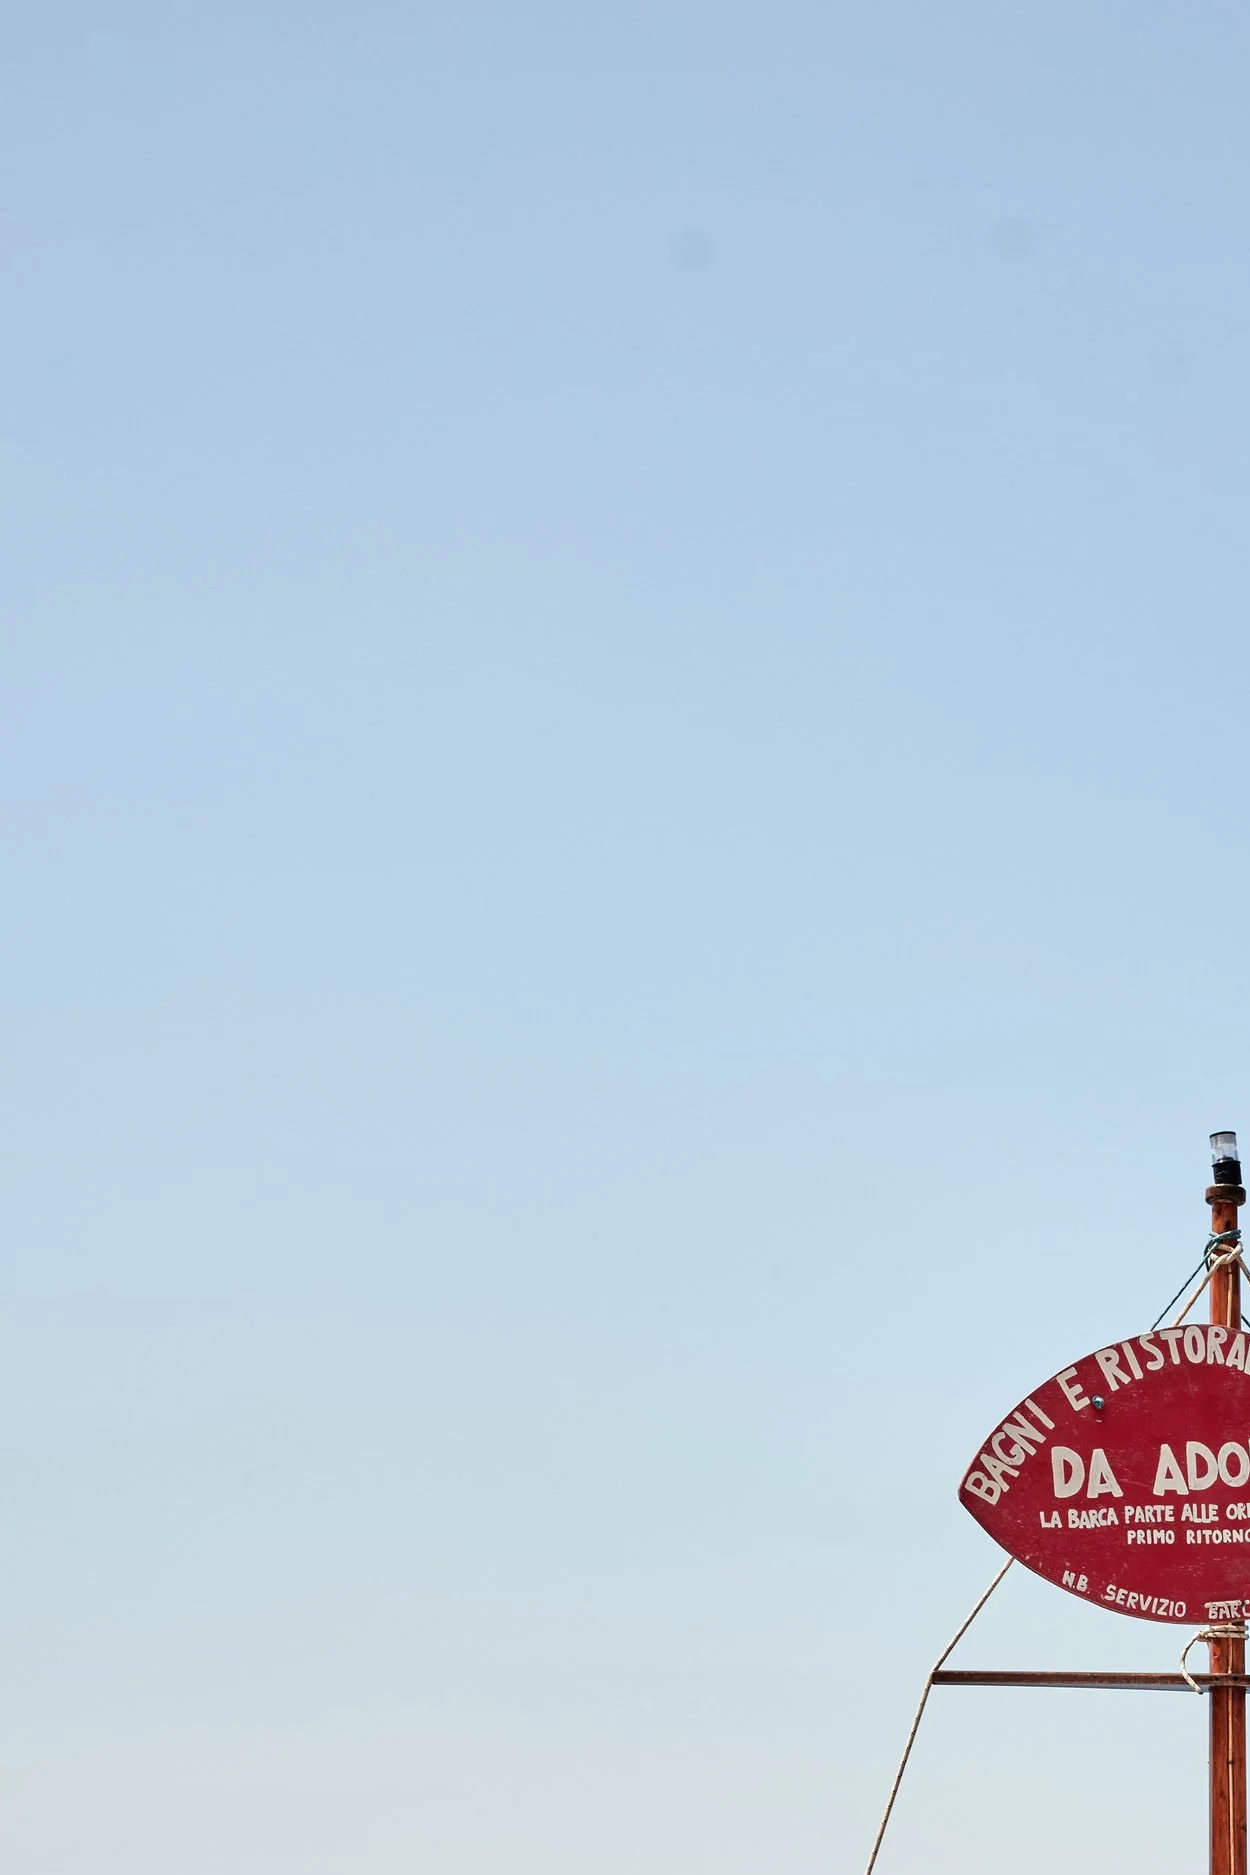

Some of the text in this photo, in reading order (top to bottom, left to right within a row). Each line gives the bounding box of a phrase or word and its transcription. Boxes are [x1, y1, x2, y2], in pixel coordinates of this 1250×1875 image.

[965, 1398, 1055, 1505] BAGNI
[1056, 1367, 1091, 1411] E
[1051, 1446, 1124, 1499] DA
[1039, 1511, 1063, 1529] LA
[1067, 1507, 1119, 1529] BARCA
[1124, 1505, 1175, 1524] PARTE
[1181, 1503, 1219, 1524] ALLE
[1127, 1529, 1175, 1545] PRIMO
[1104, 1584, 1187, 1618] SERVIZIO
